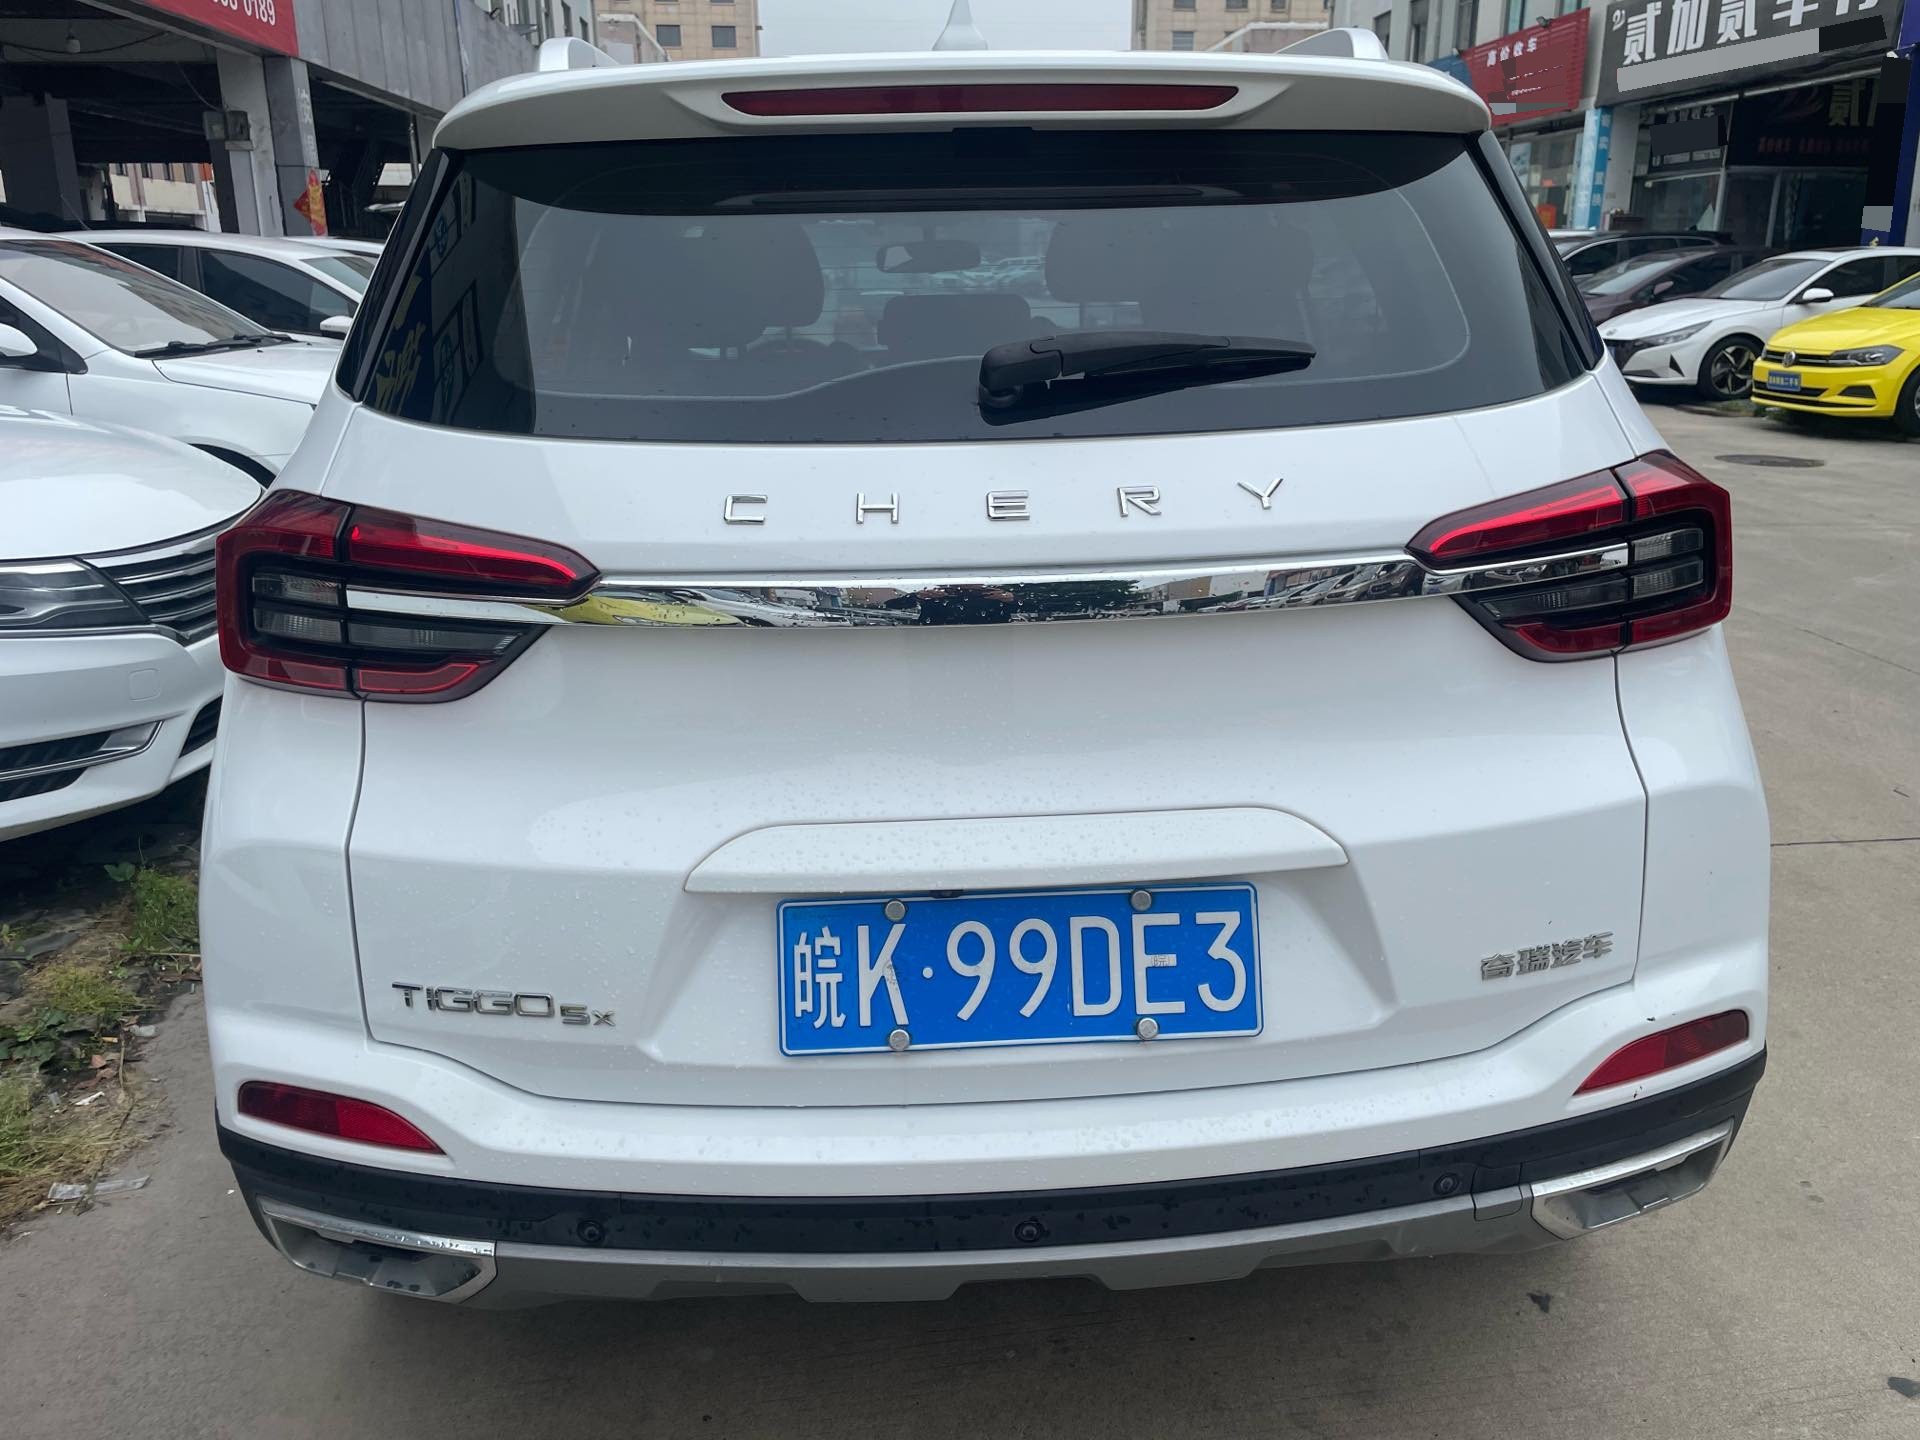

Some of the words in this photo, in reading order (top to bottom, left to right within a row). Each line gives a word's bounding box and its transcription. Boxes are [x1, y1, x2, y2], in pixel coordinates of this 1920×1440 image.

[243, 0, 276, 26] 0189
[1622, 0, 1879, 66] 贰加贰车
[723, 477, 1284, 525] CHERY
[1481, 930, 1614, 982] 奇瑞汽车
[391, 981, 556, 1018] TIGGO
